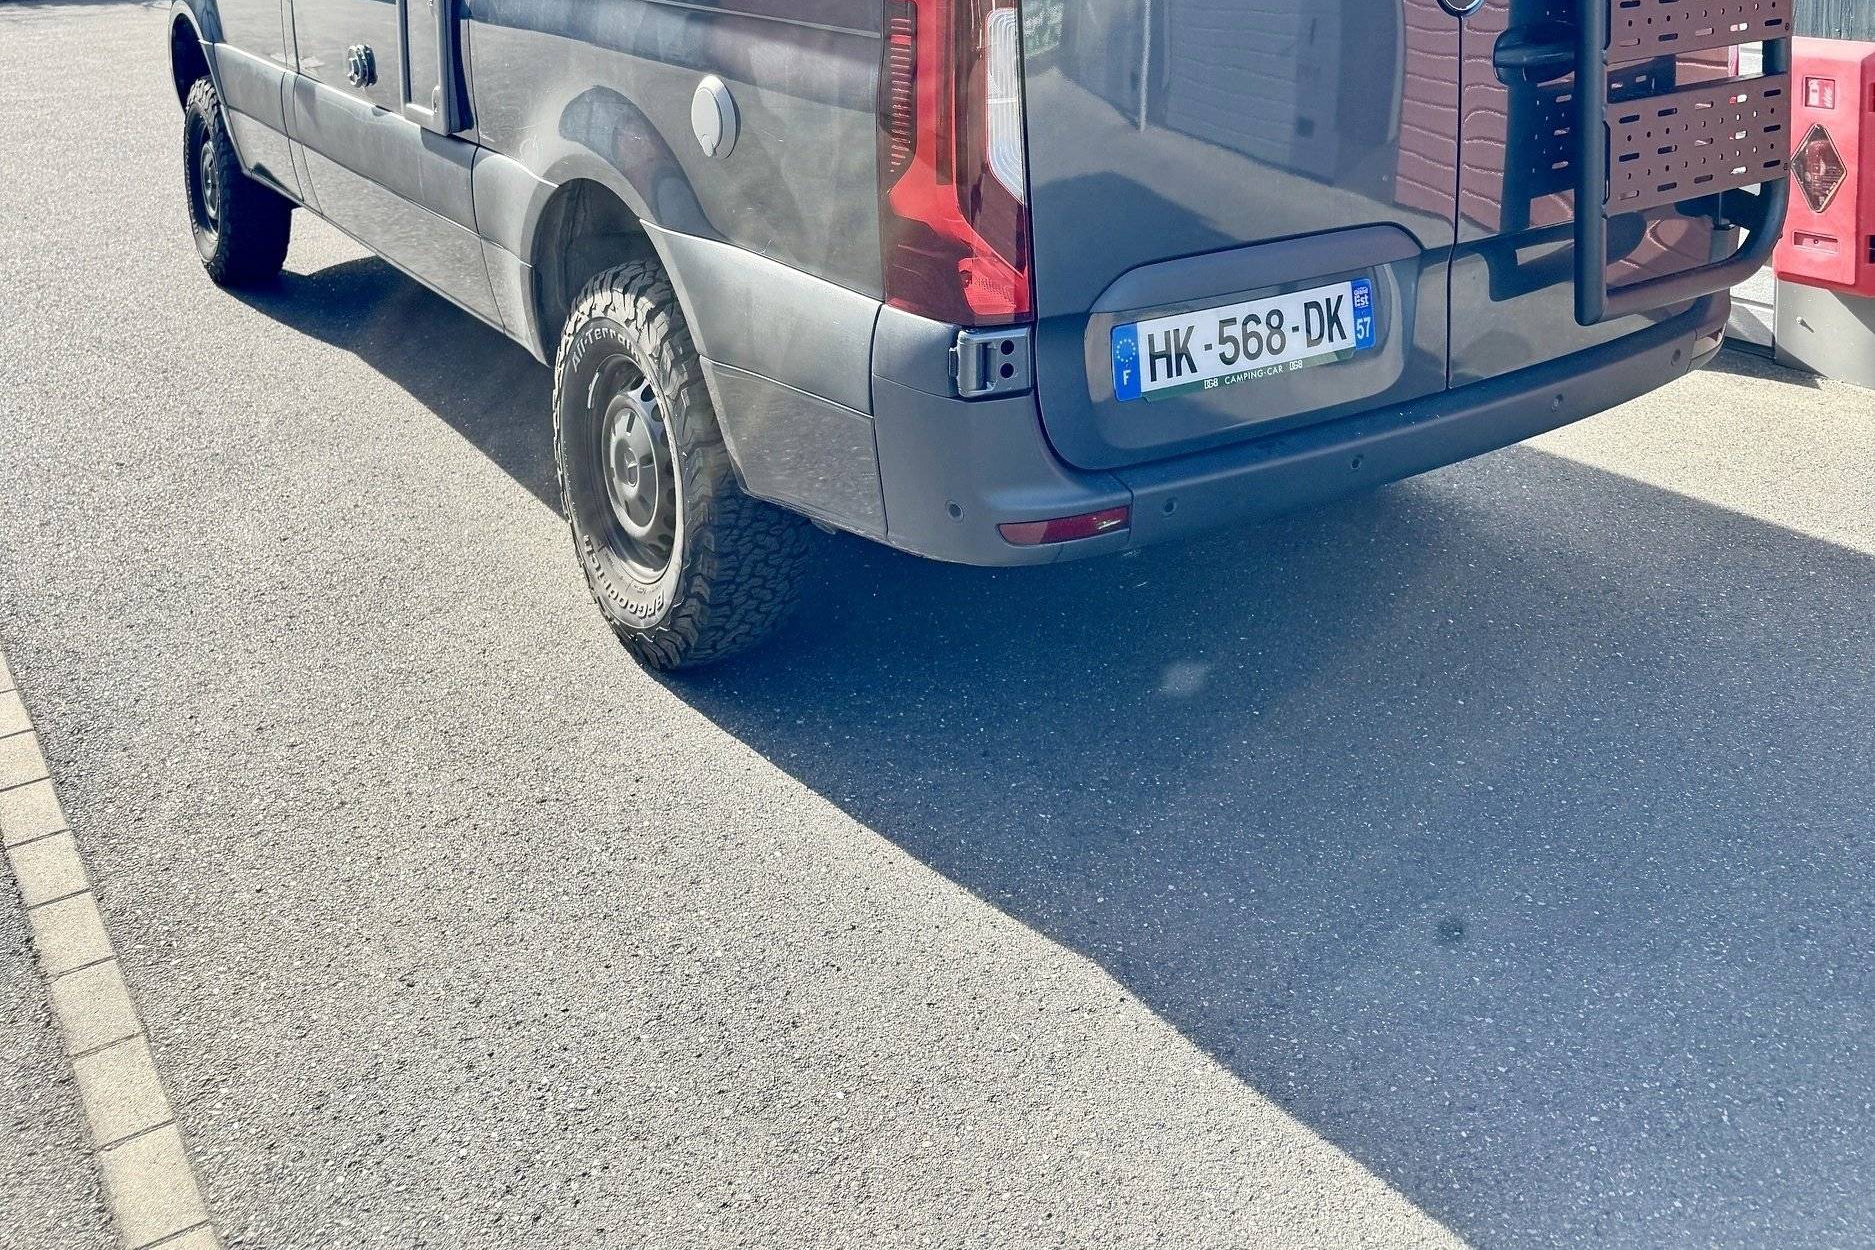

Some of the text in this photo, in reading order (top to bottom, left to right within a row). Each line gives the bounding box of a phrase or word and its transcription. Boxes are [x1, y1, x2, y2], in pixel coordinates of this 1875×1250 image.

[1354, 294, 1369, 308] Est
[1356, 316, 1371, 339] 57
[1147, 294, 1348, 383] HK-568-DK
[1123, 370, 1130, 387] F
